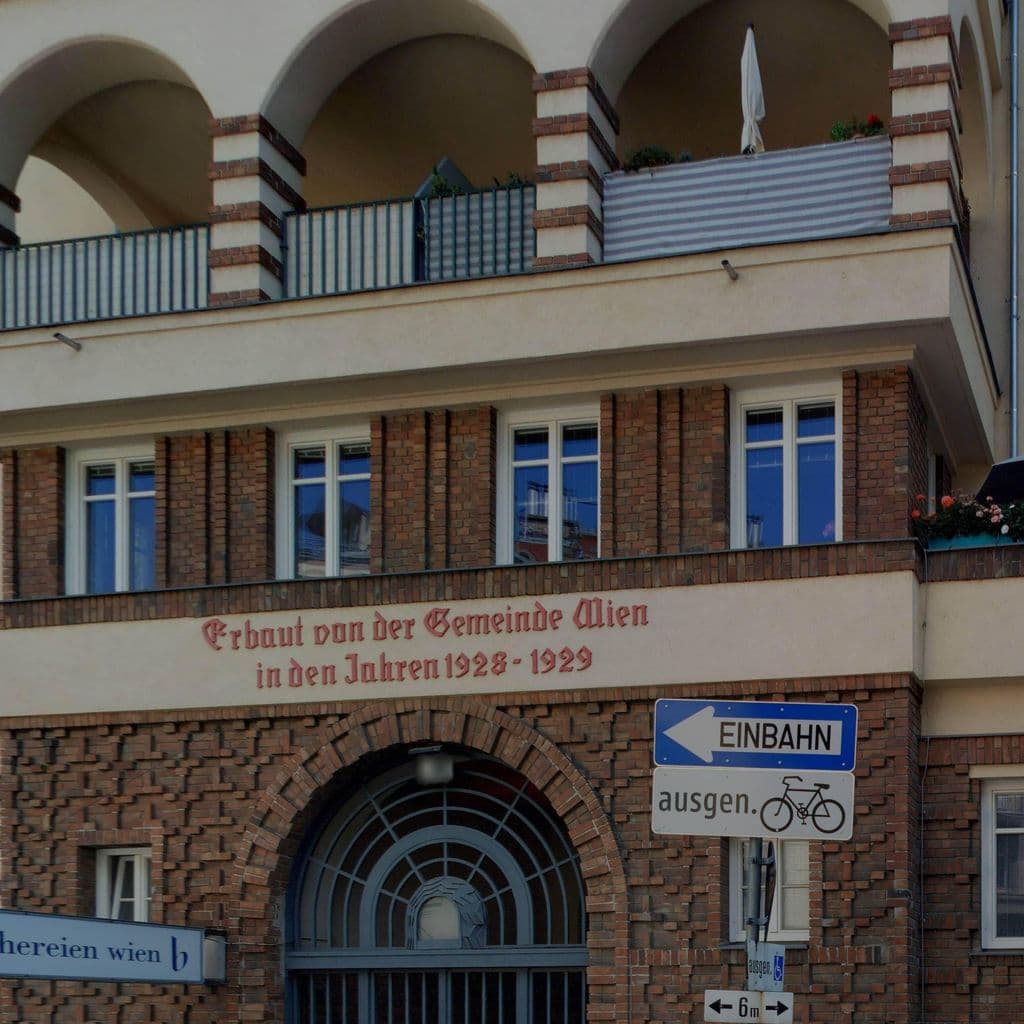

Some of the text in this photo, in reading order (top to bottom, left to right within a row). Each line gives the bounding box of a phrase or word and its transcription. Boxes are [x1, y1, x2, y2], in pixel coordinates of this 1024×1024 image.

[201, 596, 649, 651] Erbaut von der Gemeinde Wien
[256, 662, 282, 689] in
[288, 657, 337, 688] den
[344, 651, 440, 685] Jahren
[719, 721, 832, 751] EINBAHN
[658, 791, 757, 820] ausgen.
[106, 942, 161, 963] wien
